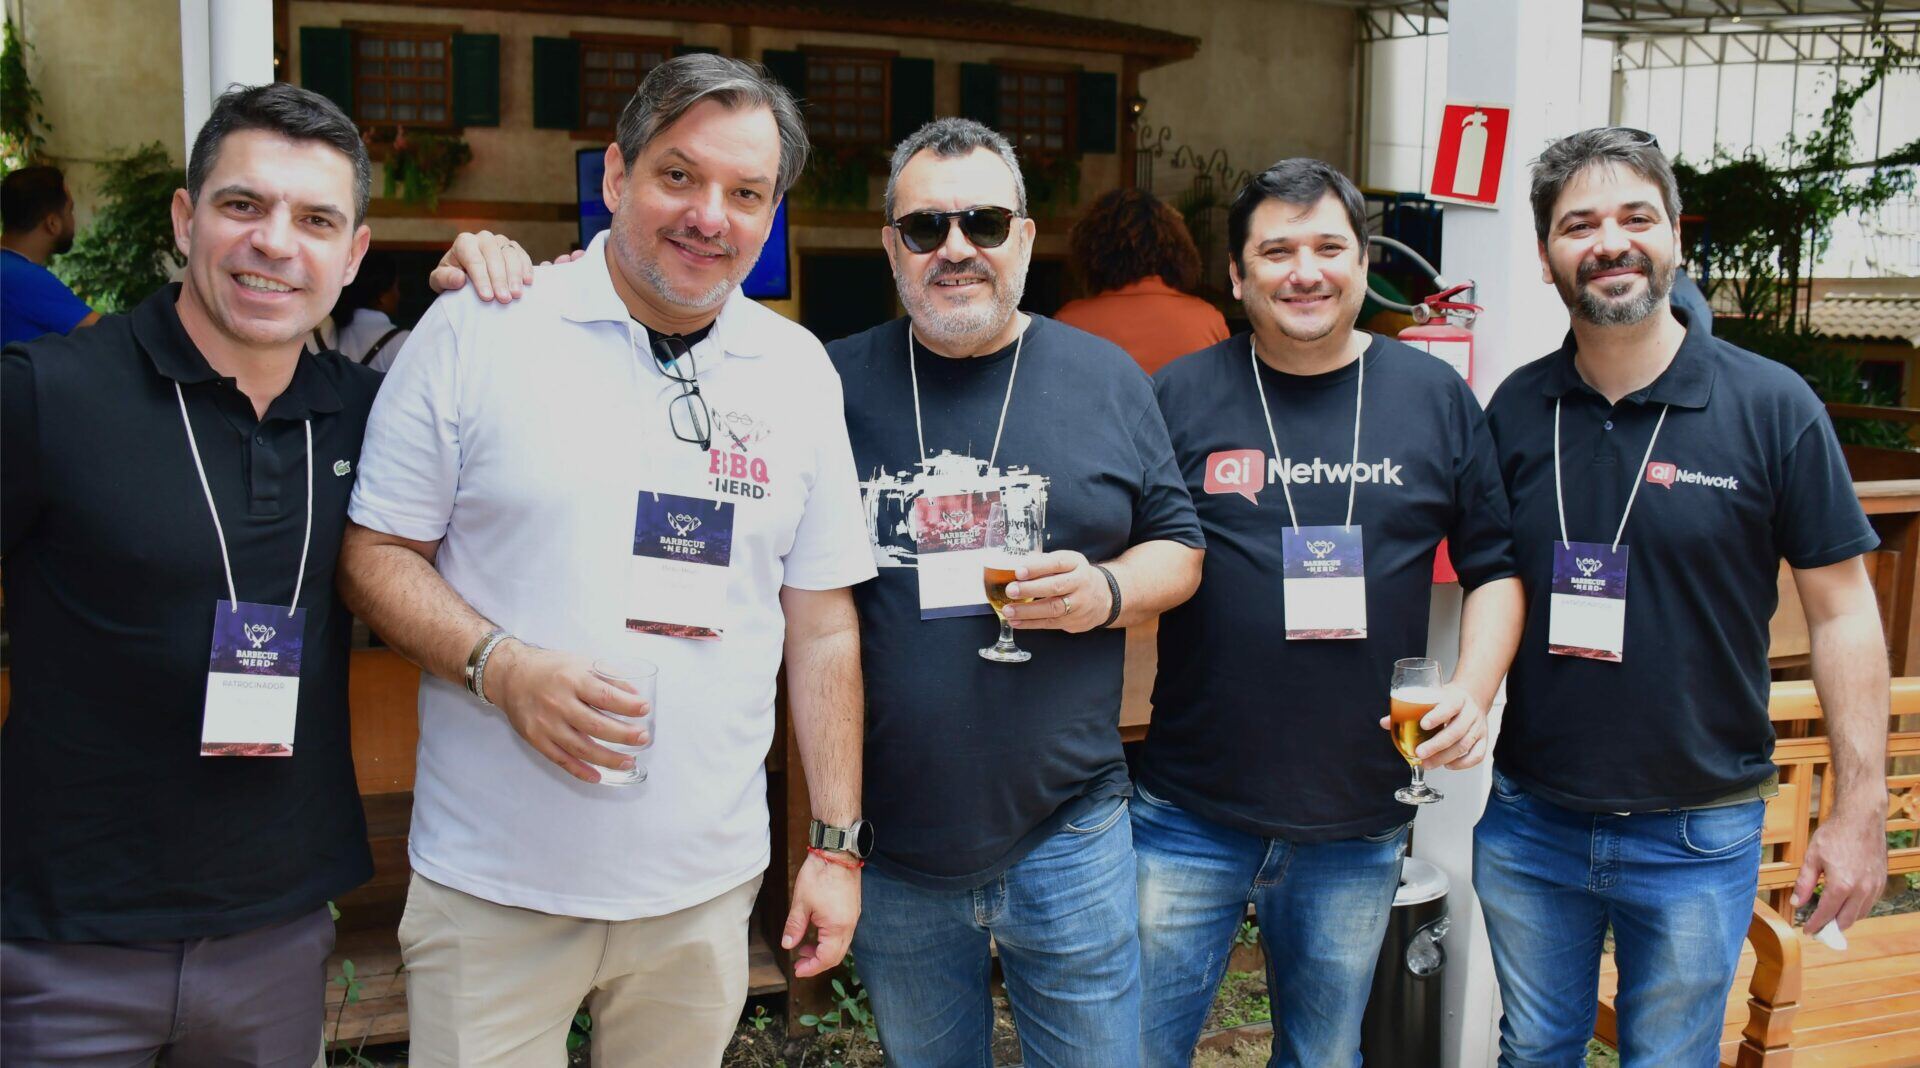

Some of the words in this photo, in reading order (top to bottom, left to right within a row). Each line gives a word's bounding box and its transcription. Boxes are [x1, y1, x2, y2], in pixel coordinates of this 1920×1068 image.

[709, 448, 770, 484] BBQ
[1214, 456, 1251, 485] Qi
[1267, 456, 1404, 486] Network
[1651, 465, 1670, 480] Qi
[1675, 469, 1739, 490] Network
[715, 477, 765, 500] NERD
[660, 535, 706, 549] BARBECUE
[236, 649, 279, 660] BARBECUE
[222, 679, 285, 690] PATROCINADOR
